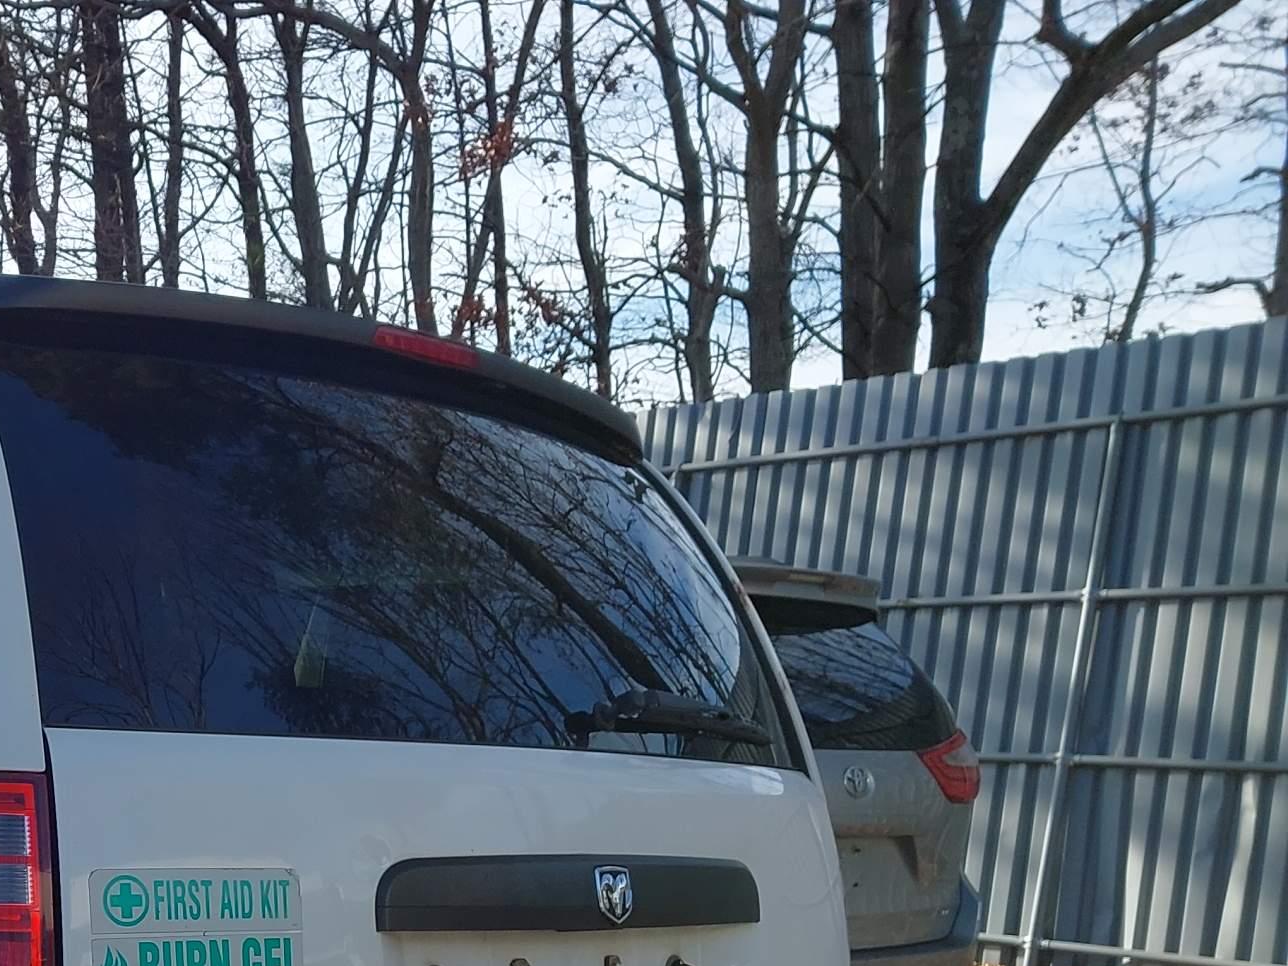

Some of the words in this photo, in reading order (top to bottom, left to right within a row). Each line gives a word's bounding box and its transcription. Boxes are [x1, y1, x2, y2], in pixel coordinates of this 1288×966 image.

[153, 880, 212, 921] FIRST
[220, 879, 253, 920] AID
[260, 879, 290, 919] KIT
